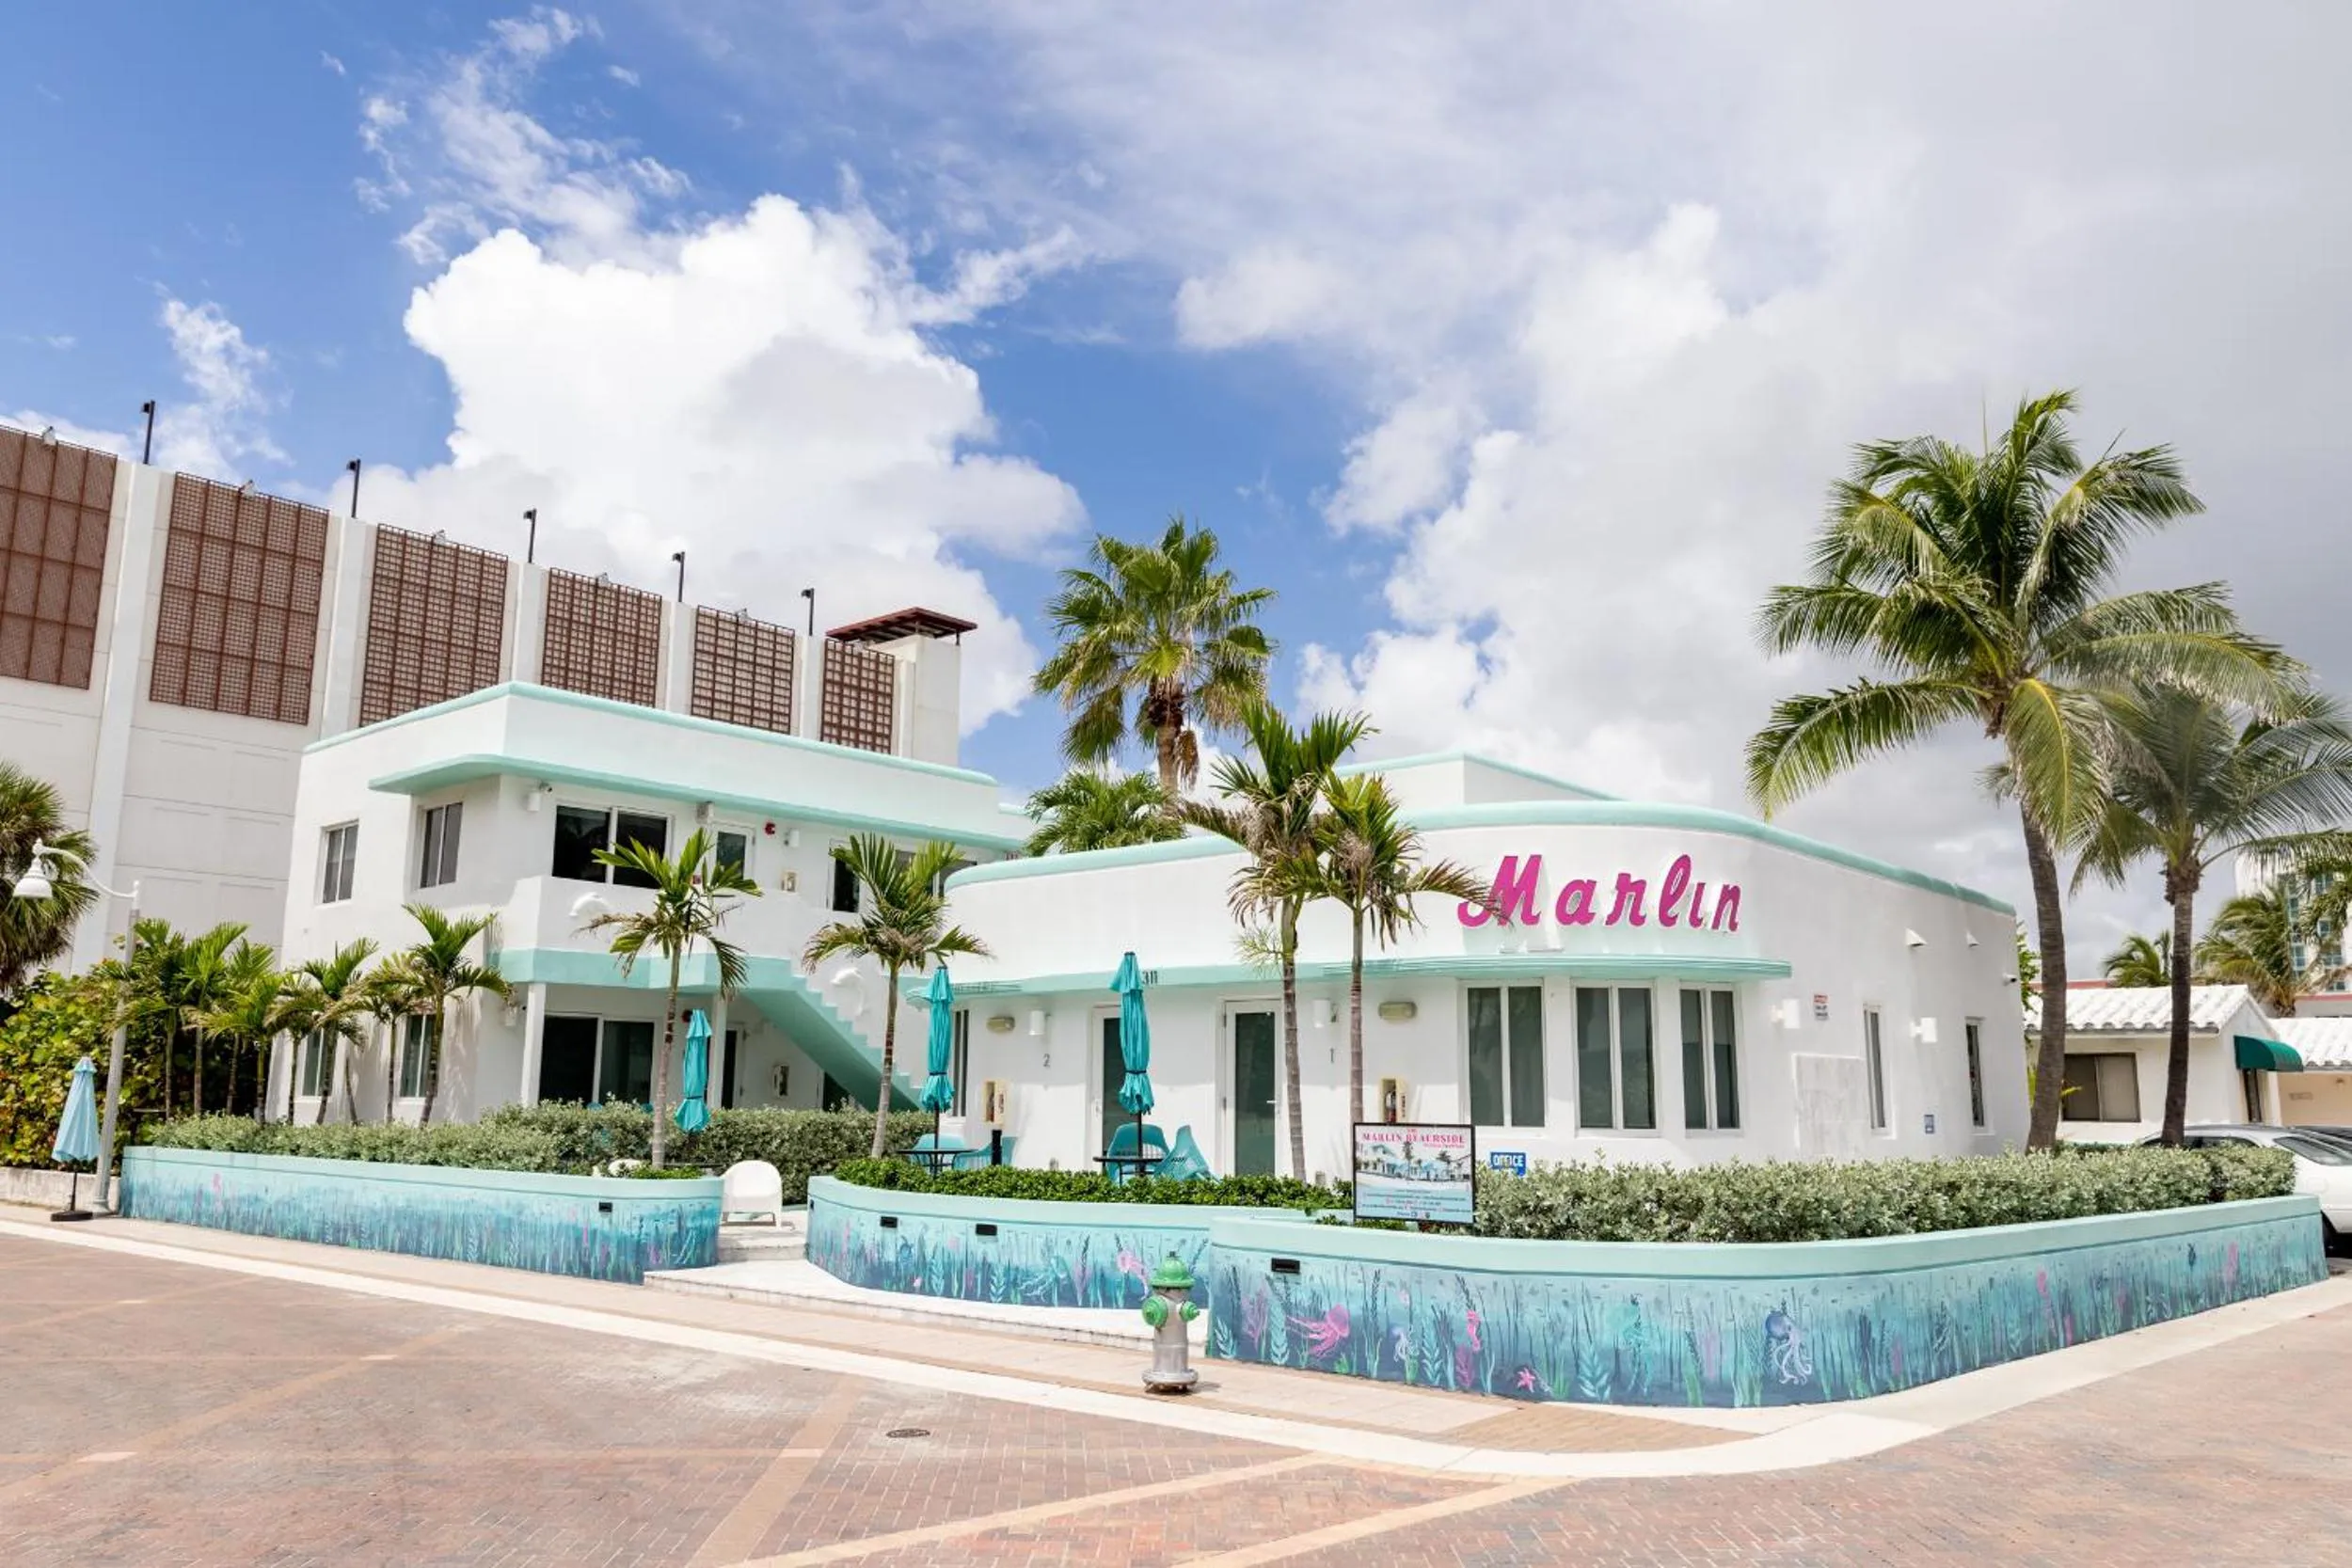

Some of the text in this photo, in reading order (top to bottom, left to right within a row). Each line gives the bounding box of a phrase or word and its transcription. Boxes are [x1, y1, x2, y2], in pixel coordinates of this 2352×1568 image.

[1457, 854, 1740, 932] Marlin
[1042, 1053, 1051, 1068] 2
[1362, 1132, 1402, 1142] MARLIN
